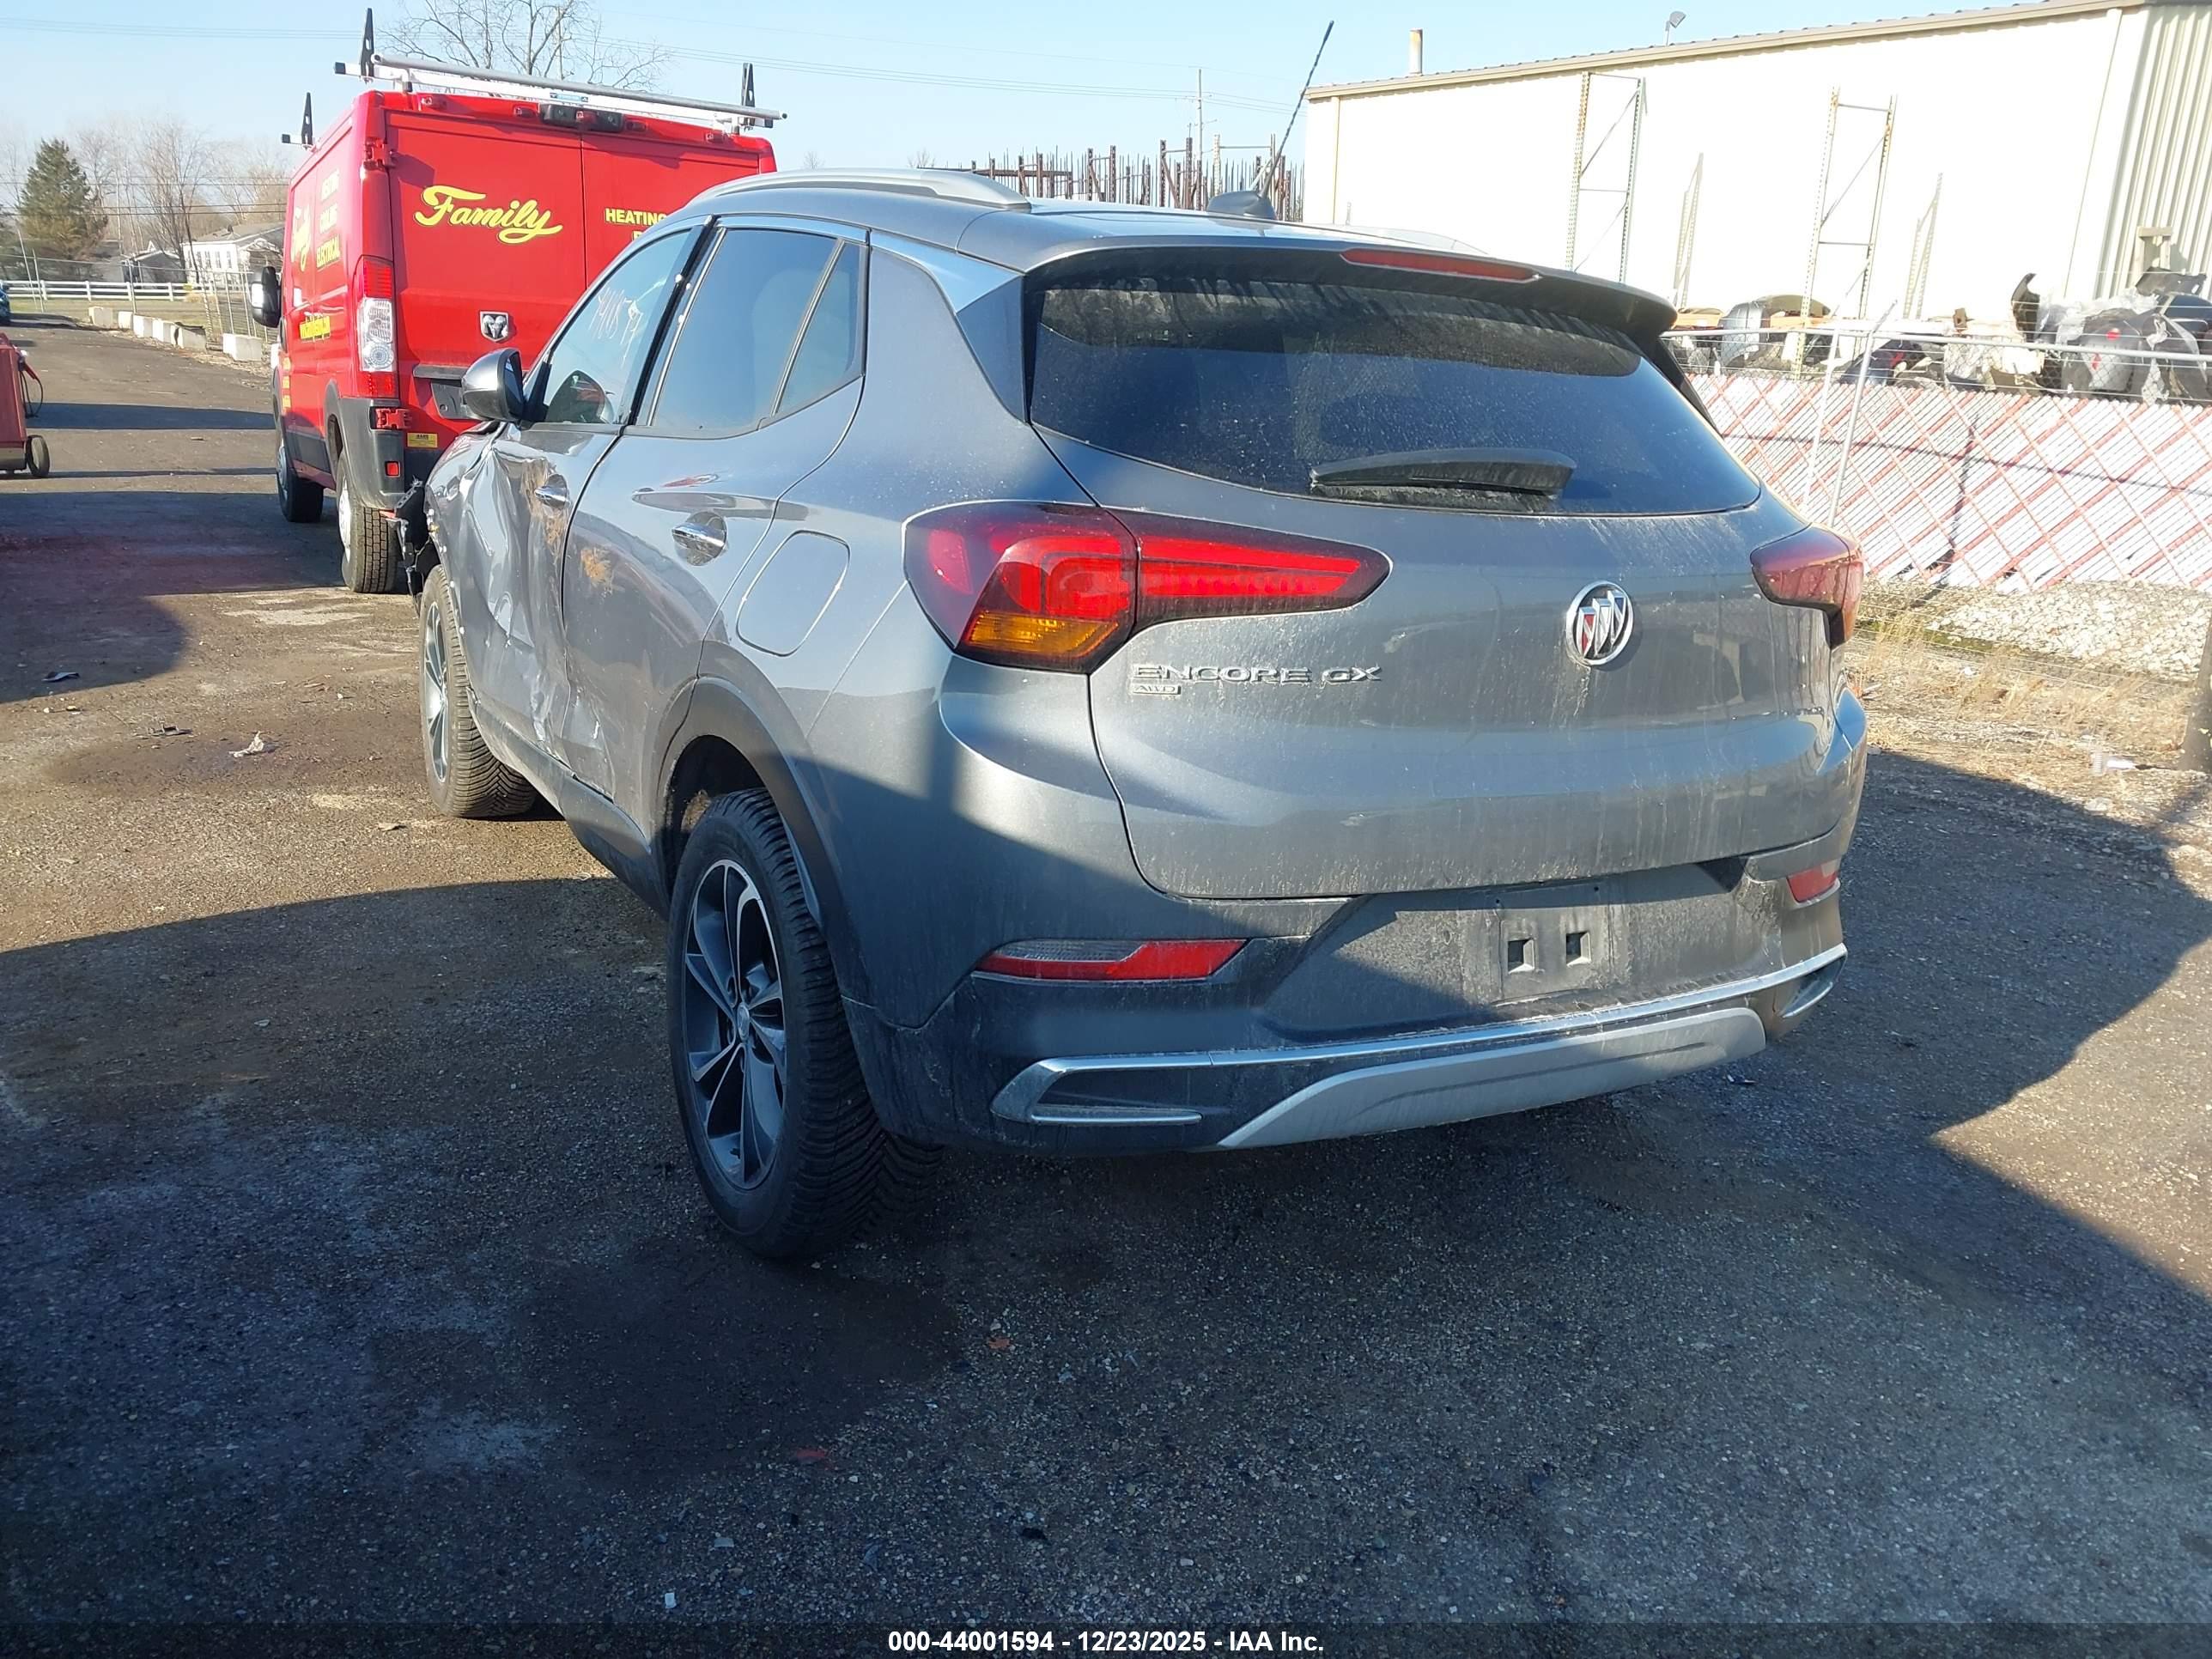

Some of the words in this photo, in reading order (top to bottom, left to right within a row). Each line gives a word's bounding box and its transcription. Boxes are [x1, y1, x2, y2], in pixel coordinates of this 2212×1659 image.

[414, 185, 563, 245] Family
[1133, 665, 1312, 684] ENCORE
[1322, 665, 1382, 683] GX
[1133, 684, 1178, 694] AWD
